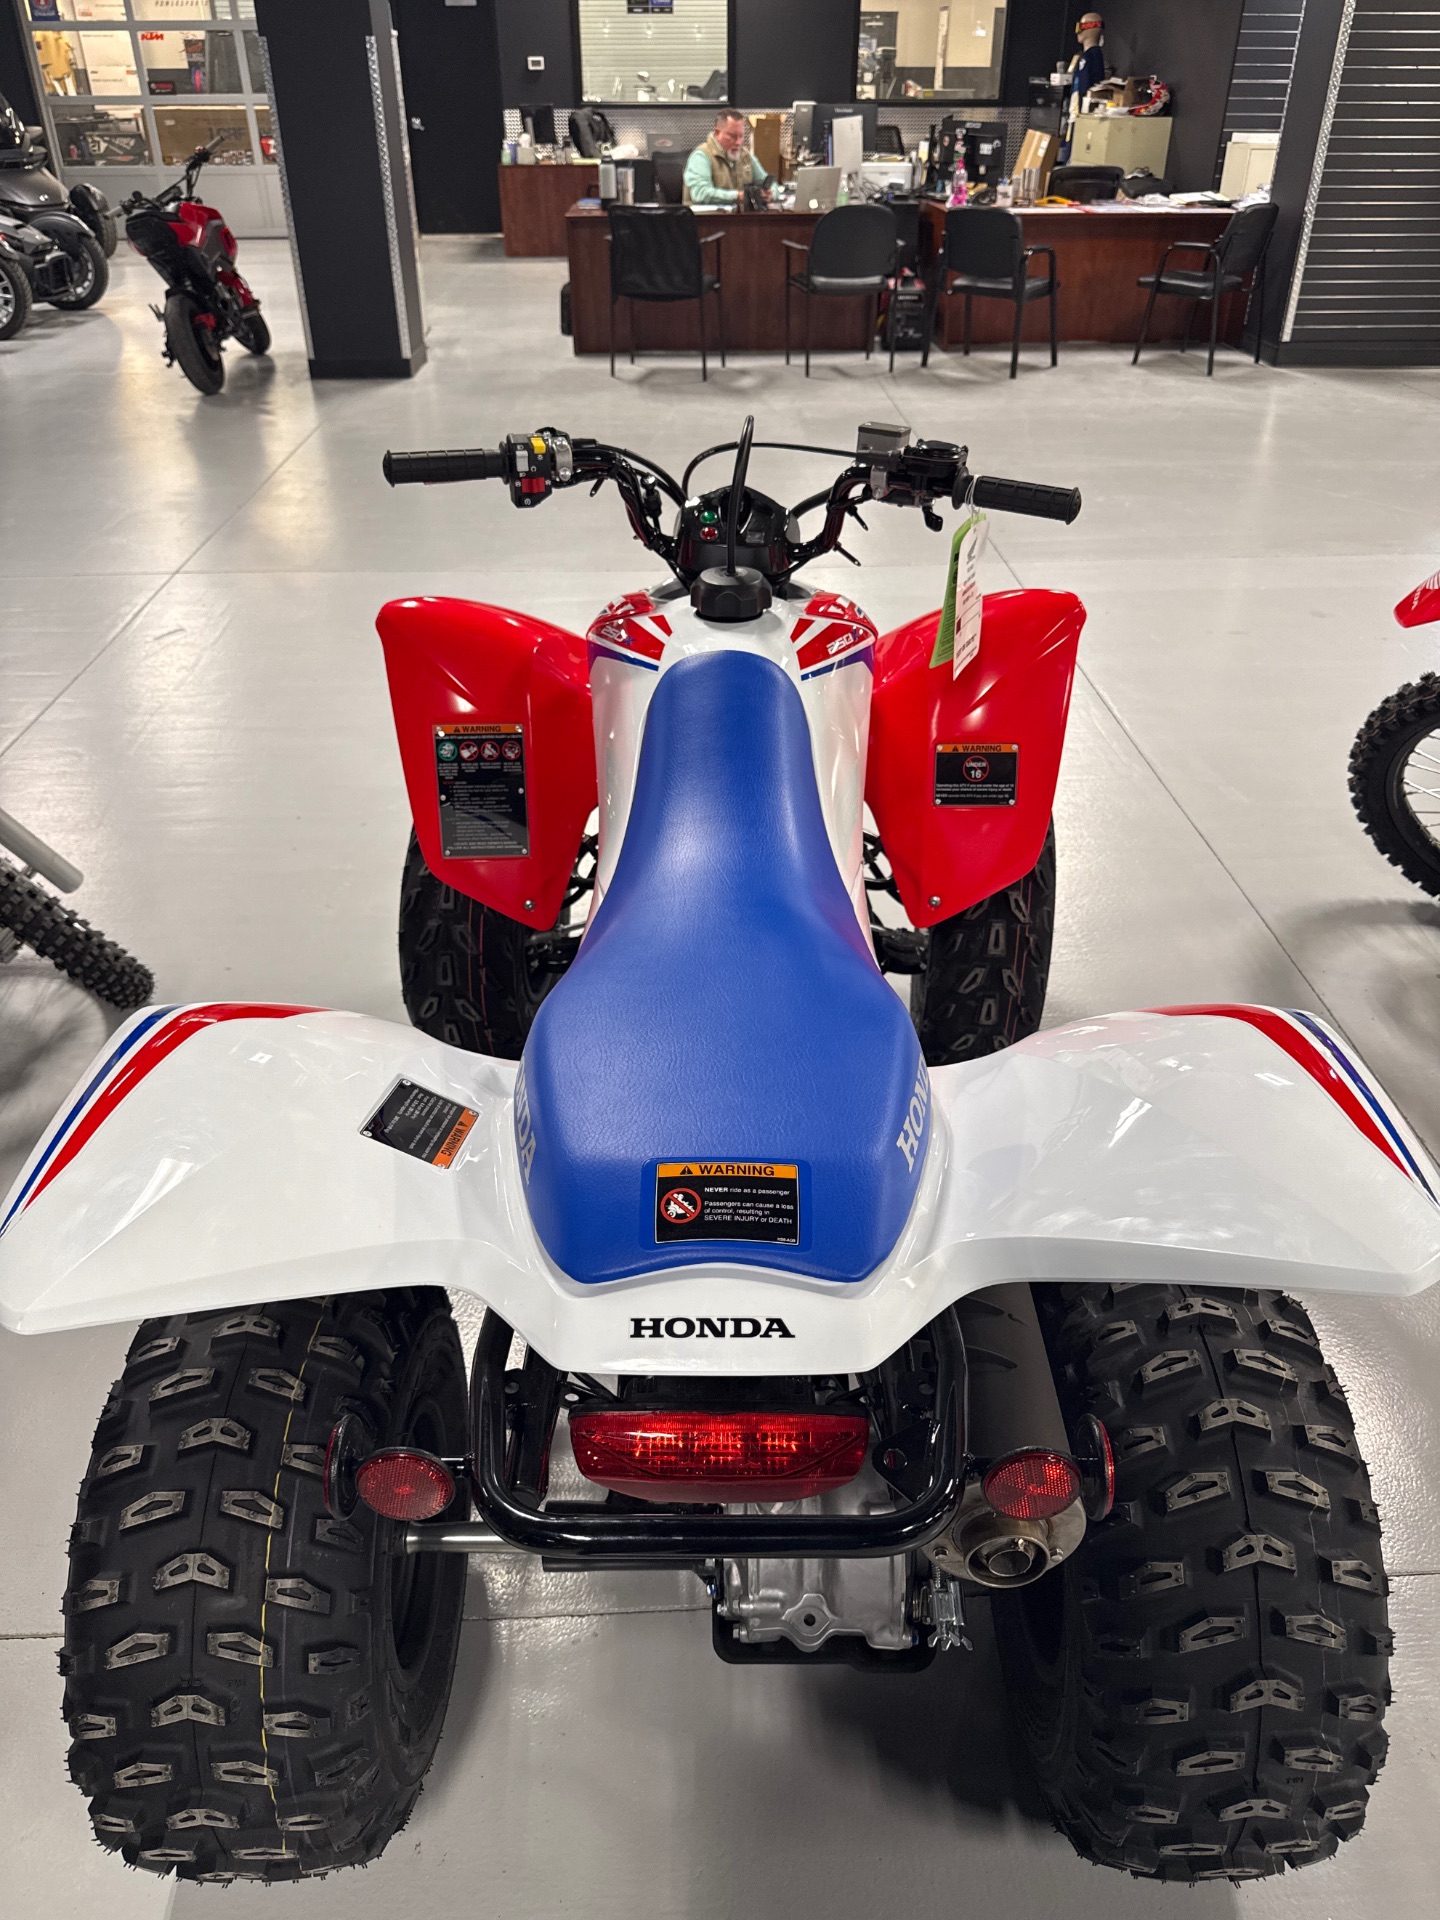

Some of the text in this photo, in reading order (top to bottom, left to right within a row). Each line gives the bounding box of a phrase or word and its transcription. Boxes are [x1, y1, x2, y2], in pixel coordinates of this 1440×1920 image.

[141, 32, 164, 41] KTM
[462, 725, 501, 733] WARNING
[970, 770, 982, 779] 16
[515, 1056, 537, 1185] ONDA
[896, 1052, 929, 1174] HOND
[441, 1127, 466, 1157] WARNING
[699, 1165, 775, 1176] WARNING
[629, 1317, 796, 1339] HONDA
